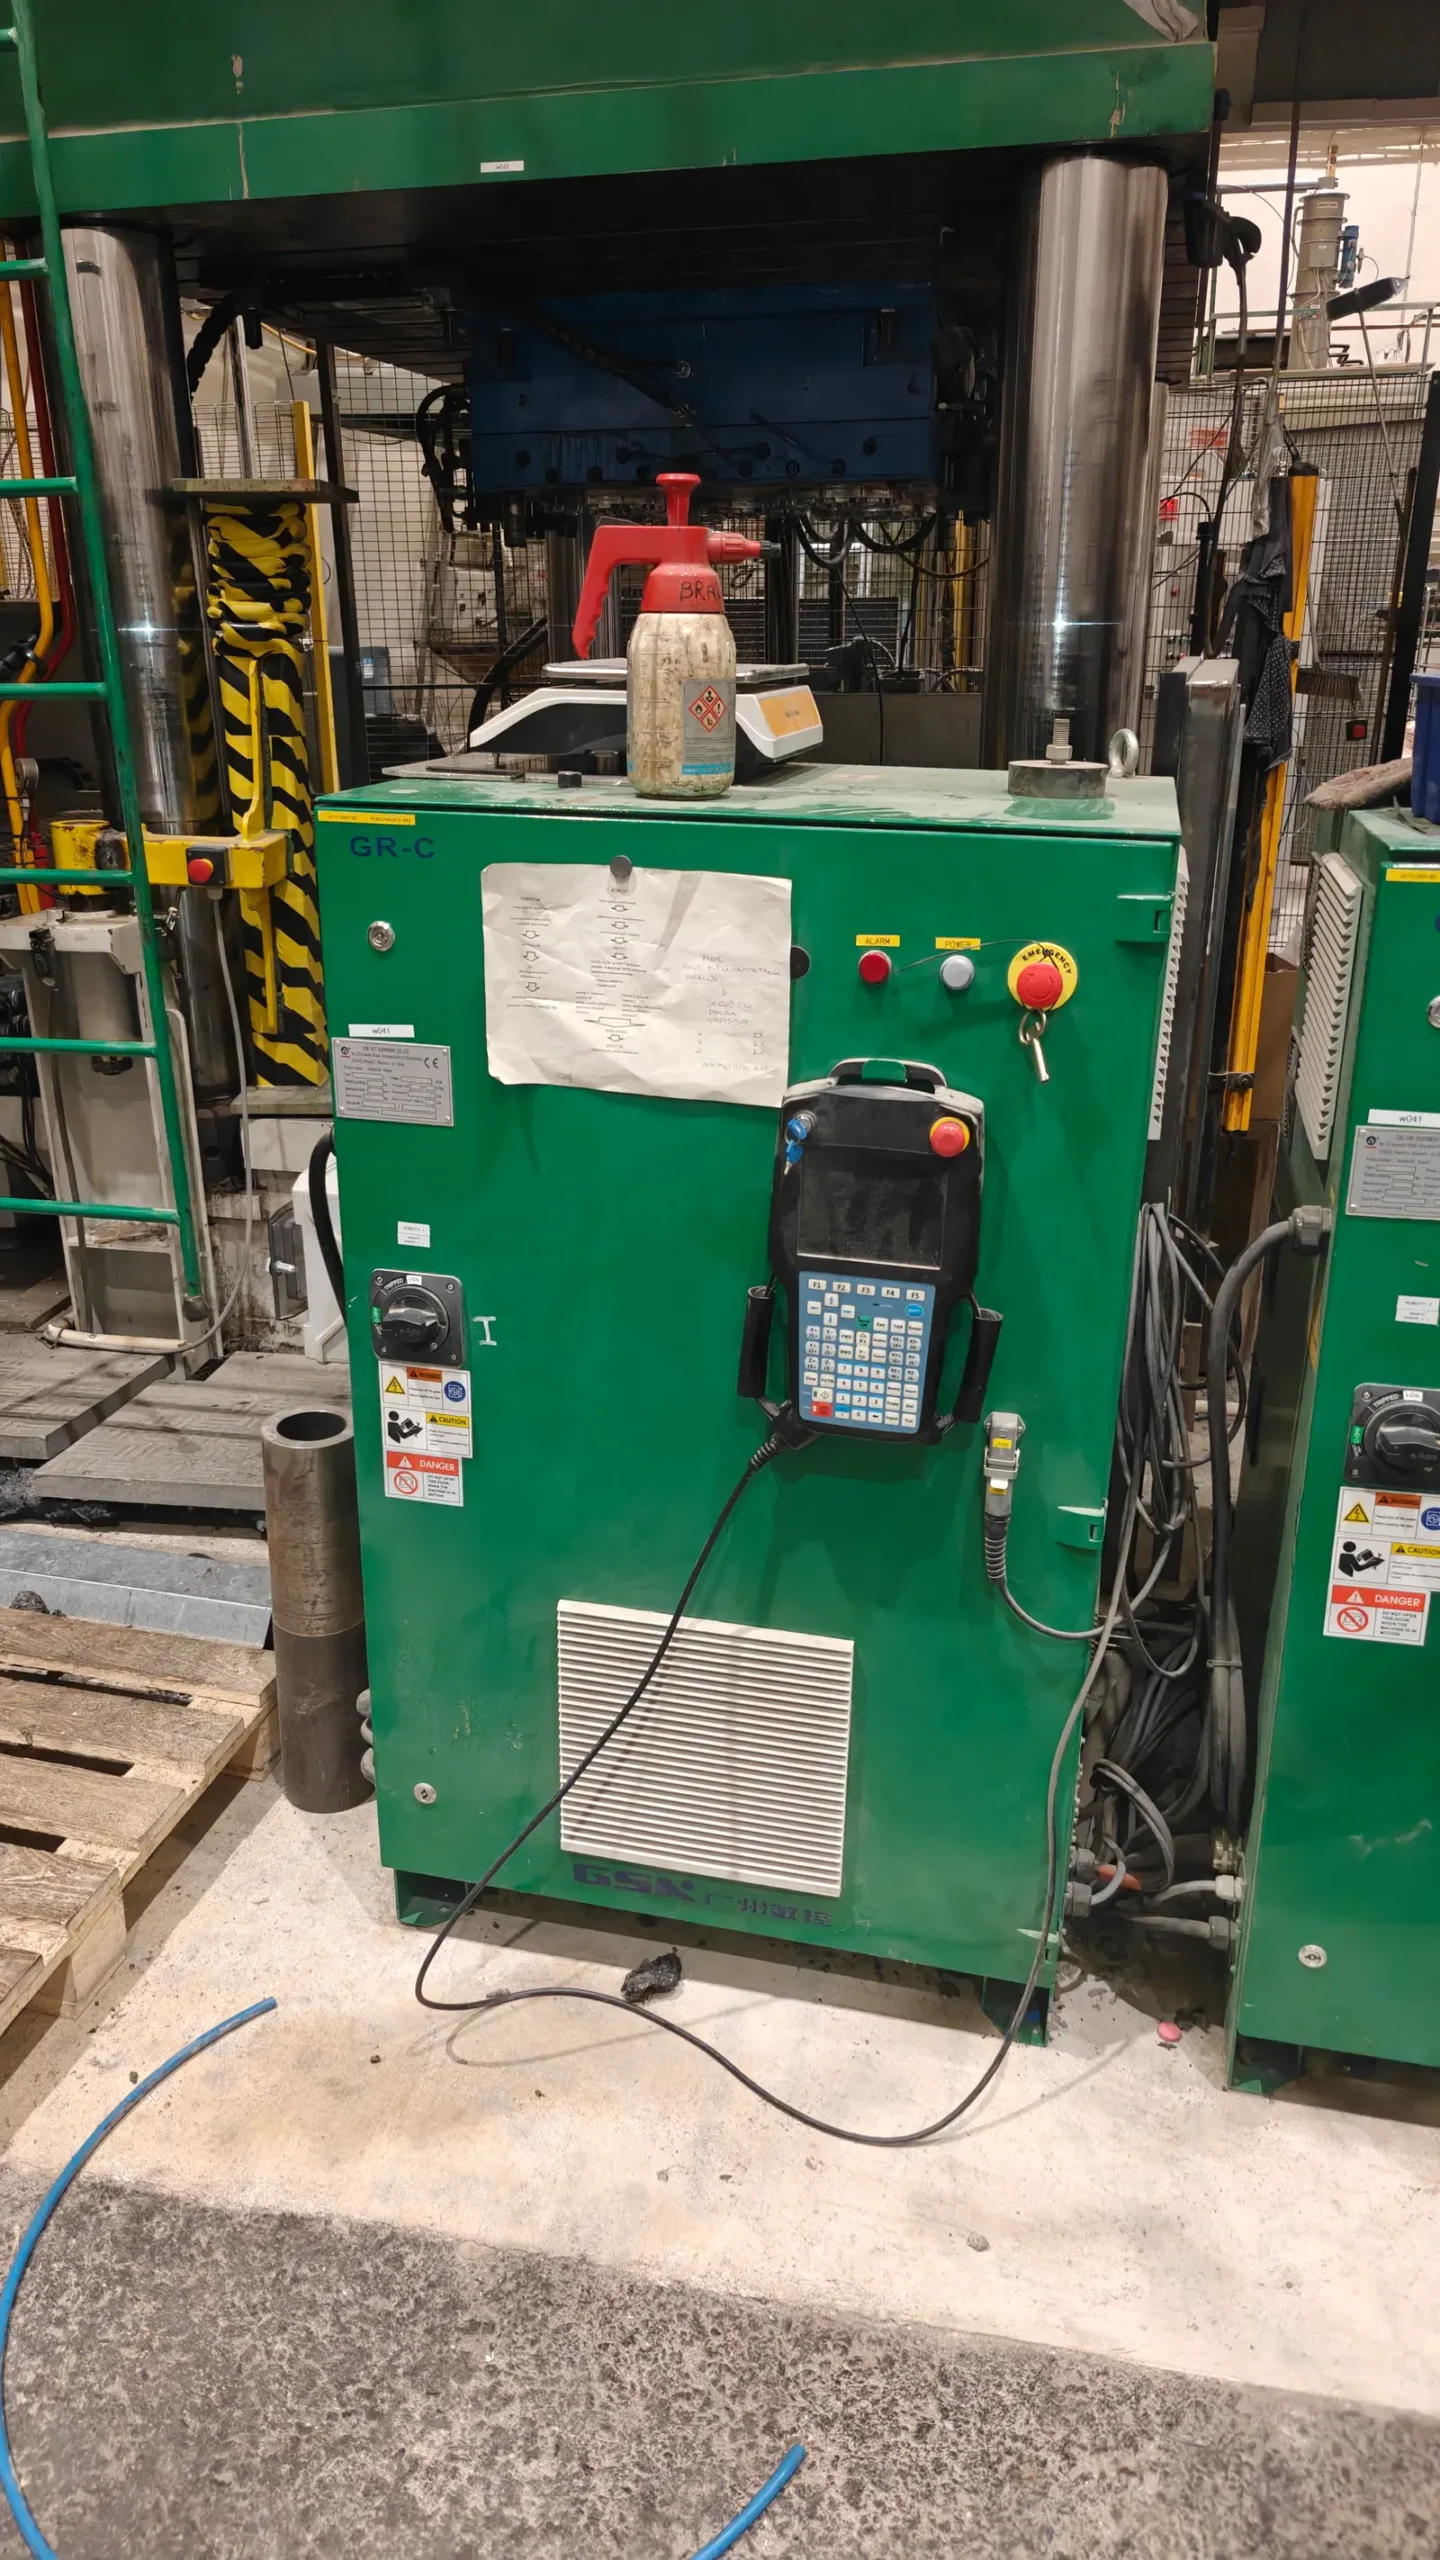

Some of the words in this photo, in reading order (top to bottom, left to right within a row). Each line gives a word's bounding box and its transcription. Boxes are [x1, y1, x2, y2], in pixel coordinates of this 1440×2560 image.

[349, 835, 435, 858] GR-C
[944, 940, 971, 949] POWER
[372, 1027, 390, 1035] w041
[1399, 1114, 1422, 1123] w041
[384, 1277, 404, 1290] TRIPPED
[886, 1289, 895, 1297] F4
[1373, 1393, 1399, 1408] TRIPPED
[438, 1416, 467, 1425] CAUTION
[420, 1460, 455, 1471] DANGER
[1375, 1594, 1420, 1607] DANGER
[573, 1862, 697, 1902] GSK
